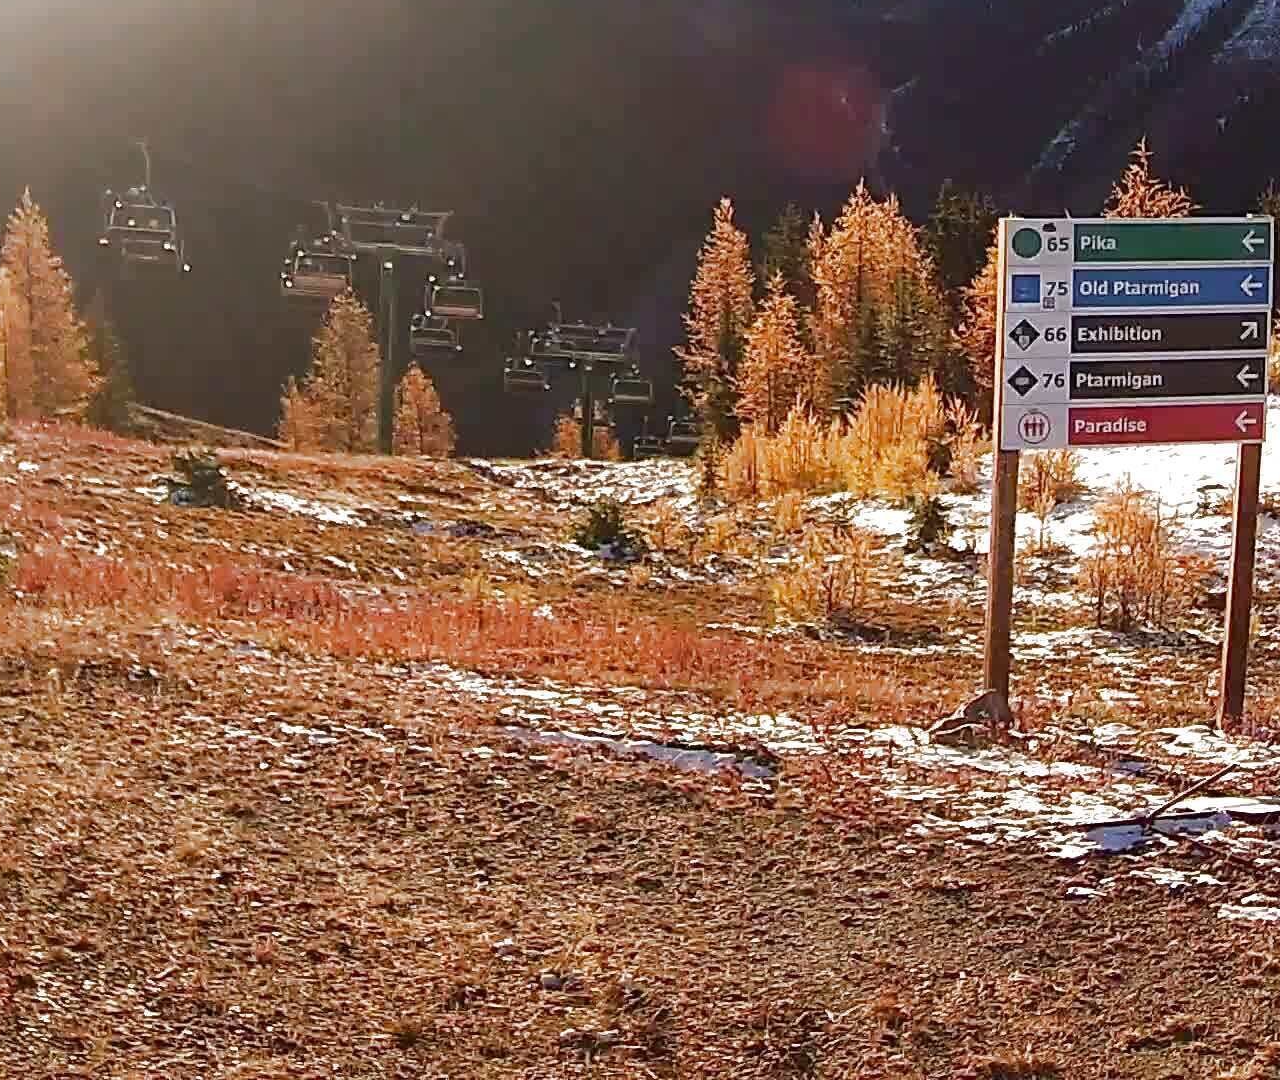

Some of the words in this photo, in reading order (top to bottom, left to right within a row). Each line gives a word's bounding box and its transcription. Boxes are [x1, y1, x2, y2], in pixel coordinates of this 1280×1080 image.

[1047, 237, 1069, 252] 65
[1080, 235, 1117, 251] Pika
[1046, 281, 1068, 296] 75
[1080, 280, 1108, 296] Old
[1113, 280, 1200, 299] Ptarmigan
[1044, 327, 1067, 342] 66
[1077, 326, 1162, 342] Exhibition
[1042, 373, 1065, 388] 76
[1076, 372, 1162, 390] Ptarmigan
[1074, 418, 1147, 434] Paradise
